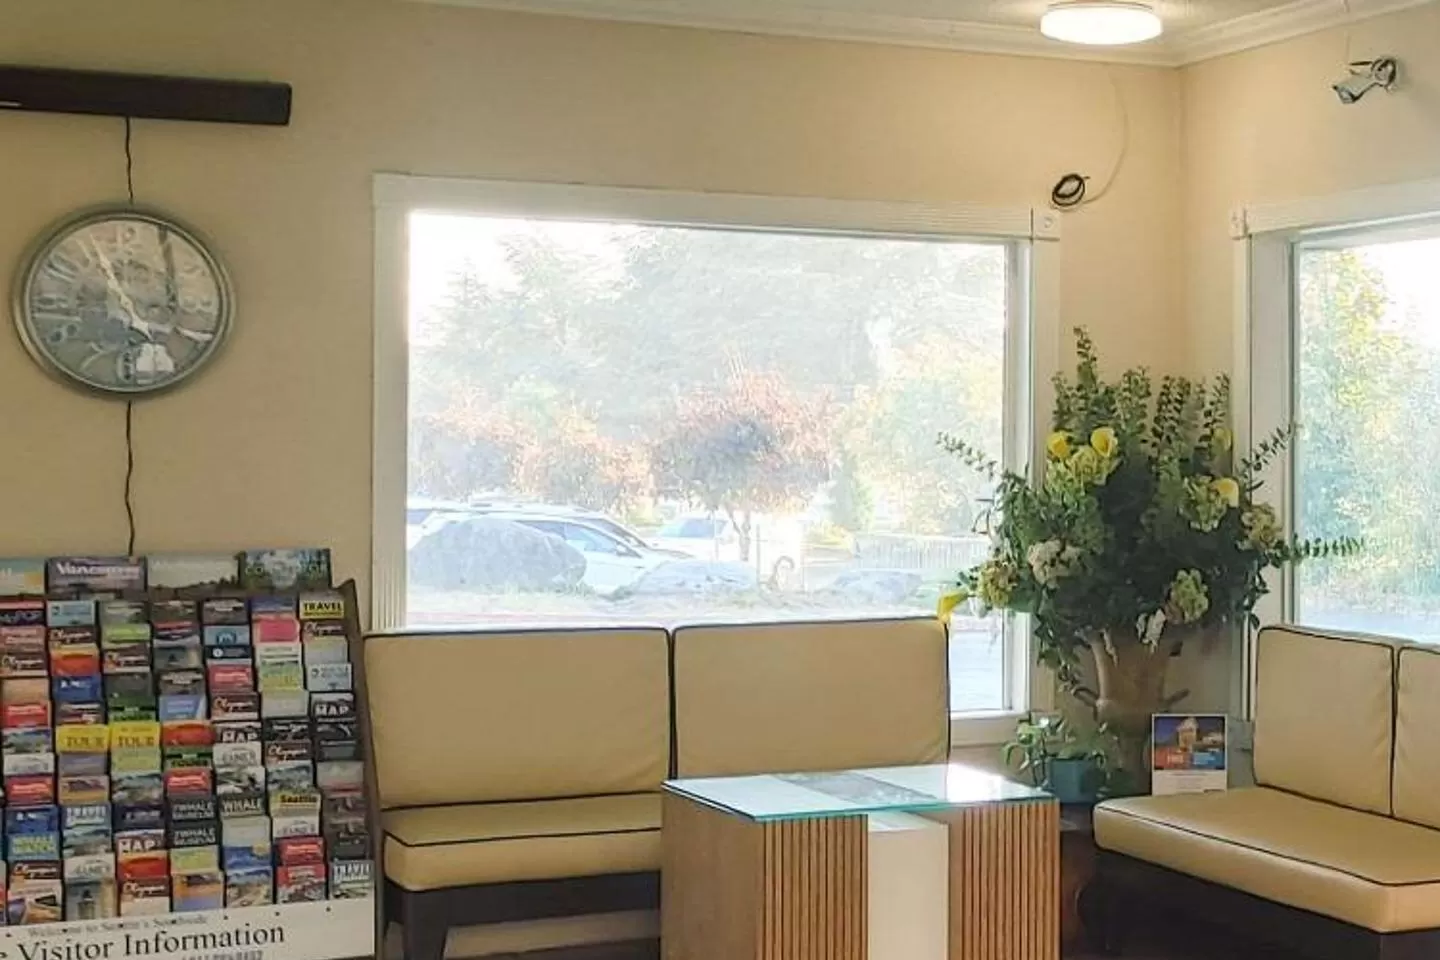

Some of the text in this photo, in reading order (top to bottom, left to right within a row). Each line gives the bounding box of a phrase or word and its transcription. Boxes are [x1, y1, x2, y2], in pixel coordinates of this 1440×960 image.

[303, 600, 342, 612] TRAVEL
[315, 702, 350, 716] MAP
[222, 729, 258, 742] MAP
[222, 797, 262, 812] WHALE
[118, 838, 156, 853] MAP
[124, 922, 285, 956] Information
